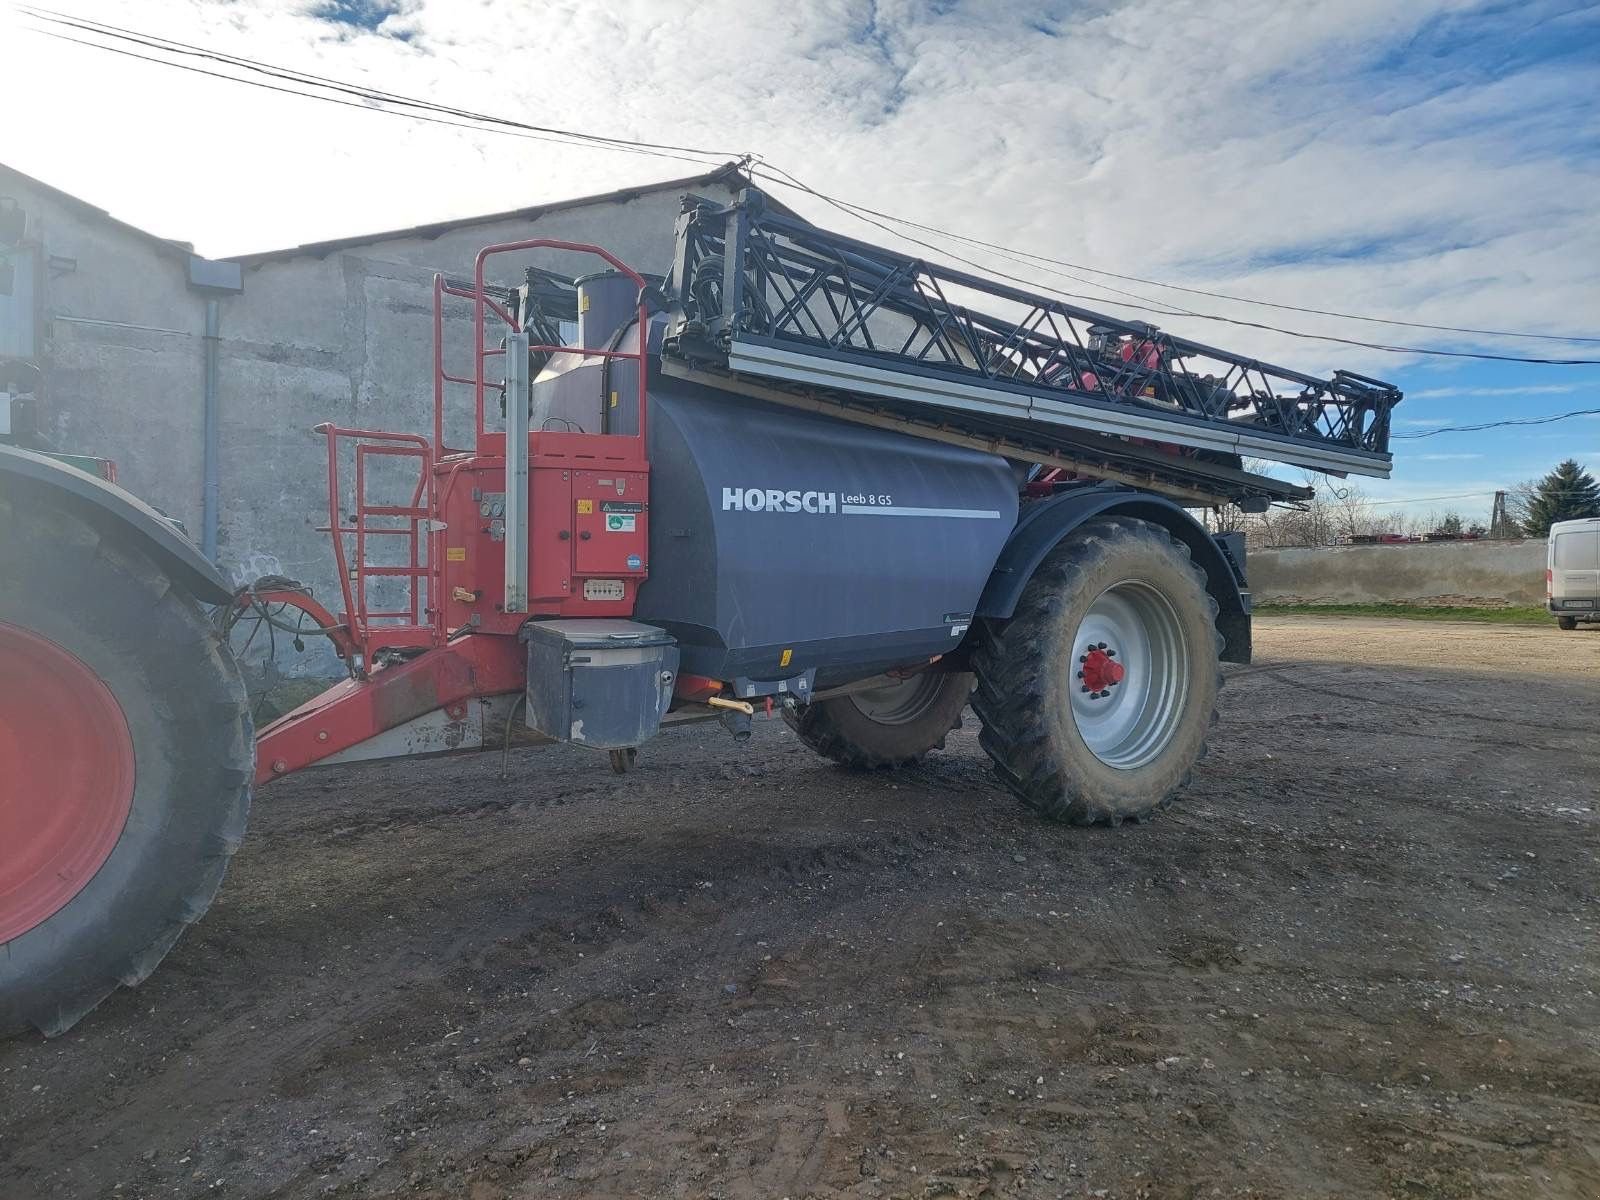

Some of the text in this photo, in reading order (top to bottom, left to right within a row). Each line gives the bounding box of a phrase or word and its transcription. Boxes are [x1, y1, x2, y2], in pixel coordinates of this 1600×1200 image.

[722, 487, 892, 514] HORSCH Leeb 8 GS
